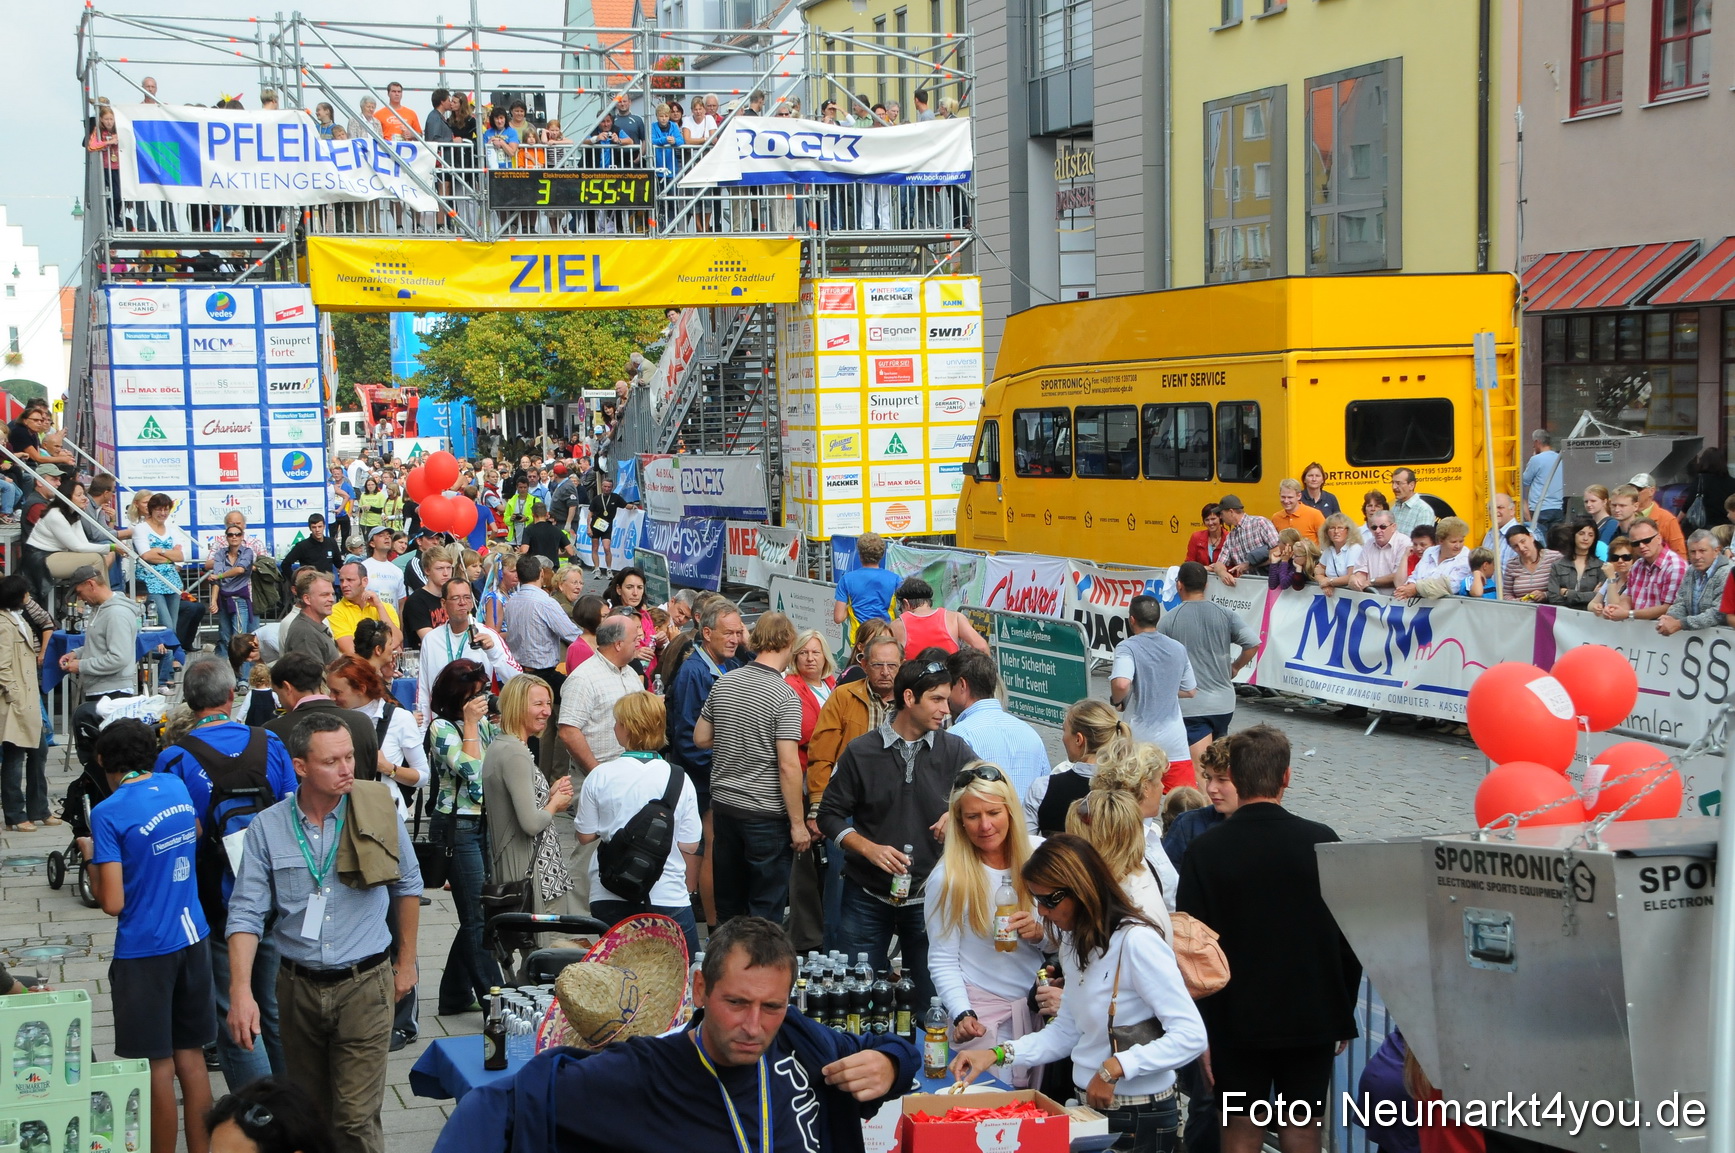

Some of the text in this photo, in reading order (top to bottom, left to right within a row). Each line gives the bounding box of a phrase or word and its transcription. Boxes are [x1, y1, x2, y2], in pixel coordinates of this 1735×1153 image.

[207, 121, 419, 178] PFLEIERER
[905, 173, 967, 182] www.bockonline.de
[536, 179, 551, 205] 3
[336, 273, 446, 287] Neumarkter Stadtlauf
[509, 254, 620, 293] ZIEL
[677, 272, 776, 283] Neumarkter Stadtlauf
[209, 310, 233, 318] vedes
[882, 327, 917, 336] Egner
[929, 327, 963, 338] swn
[192, 338, 233, 351] MCM
[269, 336, 312, 347] Sinupret
[271, 347, 295, 357] forte
[878, 360, 889, 368] GUT
[1040, 377, 1083, 391] SPORTRONIC
[1161, 370, 1226, 388] EVENT SERVICE
[269, 381, 301, 391] swn
[870, 395, 919, 408] Sinupret
[871, 409, 900, 421] forte
[142, 456, 181, 465] universa
[219, 468, 238, 477] Braun
[285, 469, 309, 477] vedes
[1323, 469, 1380, 480] ORTRONIC
[1420, 467, 1436, 475] 7195
[681, 468, 725, 496] BOCK
[1415, 475, 1463, 483] portronic-gbr.de
[276, 498, 307, 509] MCM
[653, 521, 701, 558] universa
[669, 560, 699, 579] ERUNGEN
[1211, 594, 1252, 611] Kastengasse
[1010, 626, 1051, 643] Event-Leit-Systeme
[1292, 594, 1435, 676] MCM
[1001, 652, 1057, 676] Mehr Sicherheit
[1002, 671, 1049, 694] für Ihr Event!
[1282, 675, 1304, 687] MICRO
[1305, 679, 1345, 695] COMPUTER
[1346, 687, 1381, 701] MANAGING
[1387, 694, 1430, 708] COMPUTER
[1014, 700, 1019, 709] &
[1019, 701, 1034, 713] Service
[1034, 703, 1046, 715] Line:
[1045, 705, 1059, 719] 09181
[1434, 847, 1566, 884] SPORTRONIC
[1437, 876, 1485, 892] ELECTRONIC
[1486, 881, 1518, 895] SPORTS
[1643, 896, 1714, 912] ELECTRON
[15, 1081, 51, 1092] NEUMARKTER
